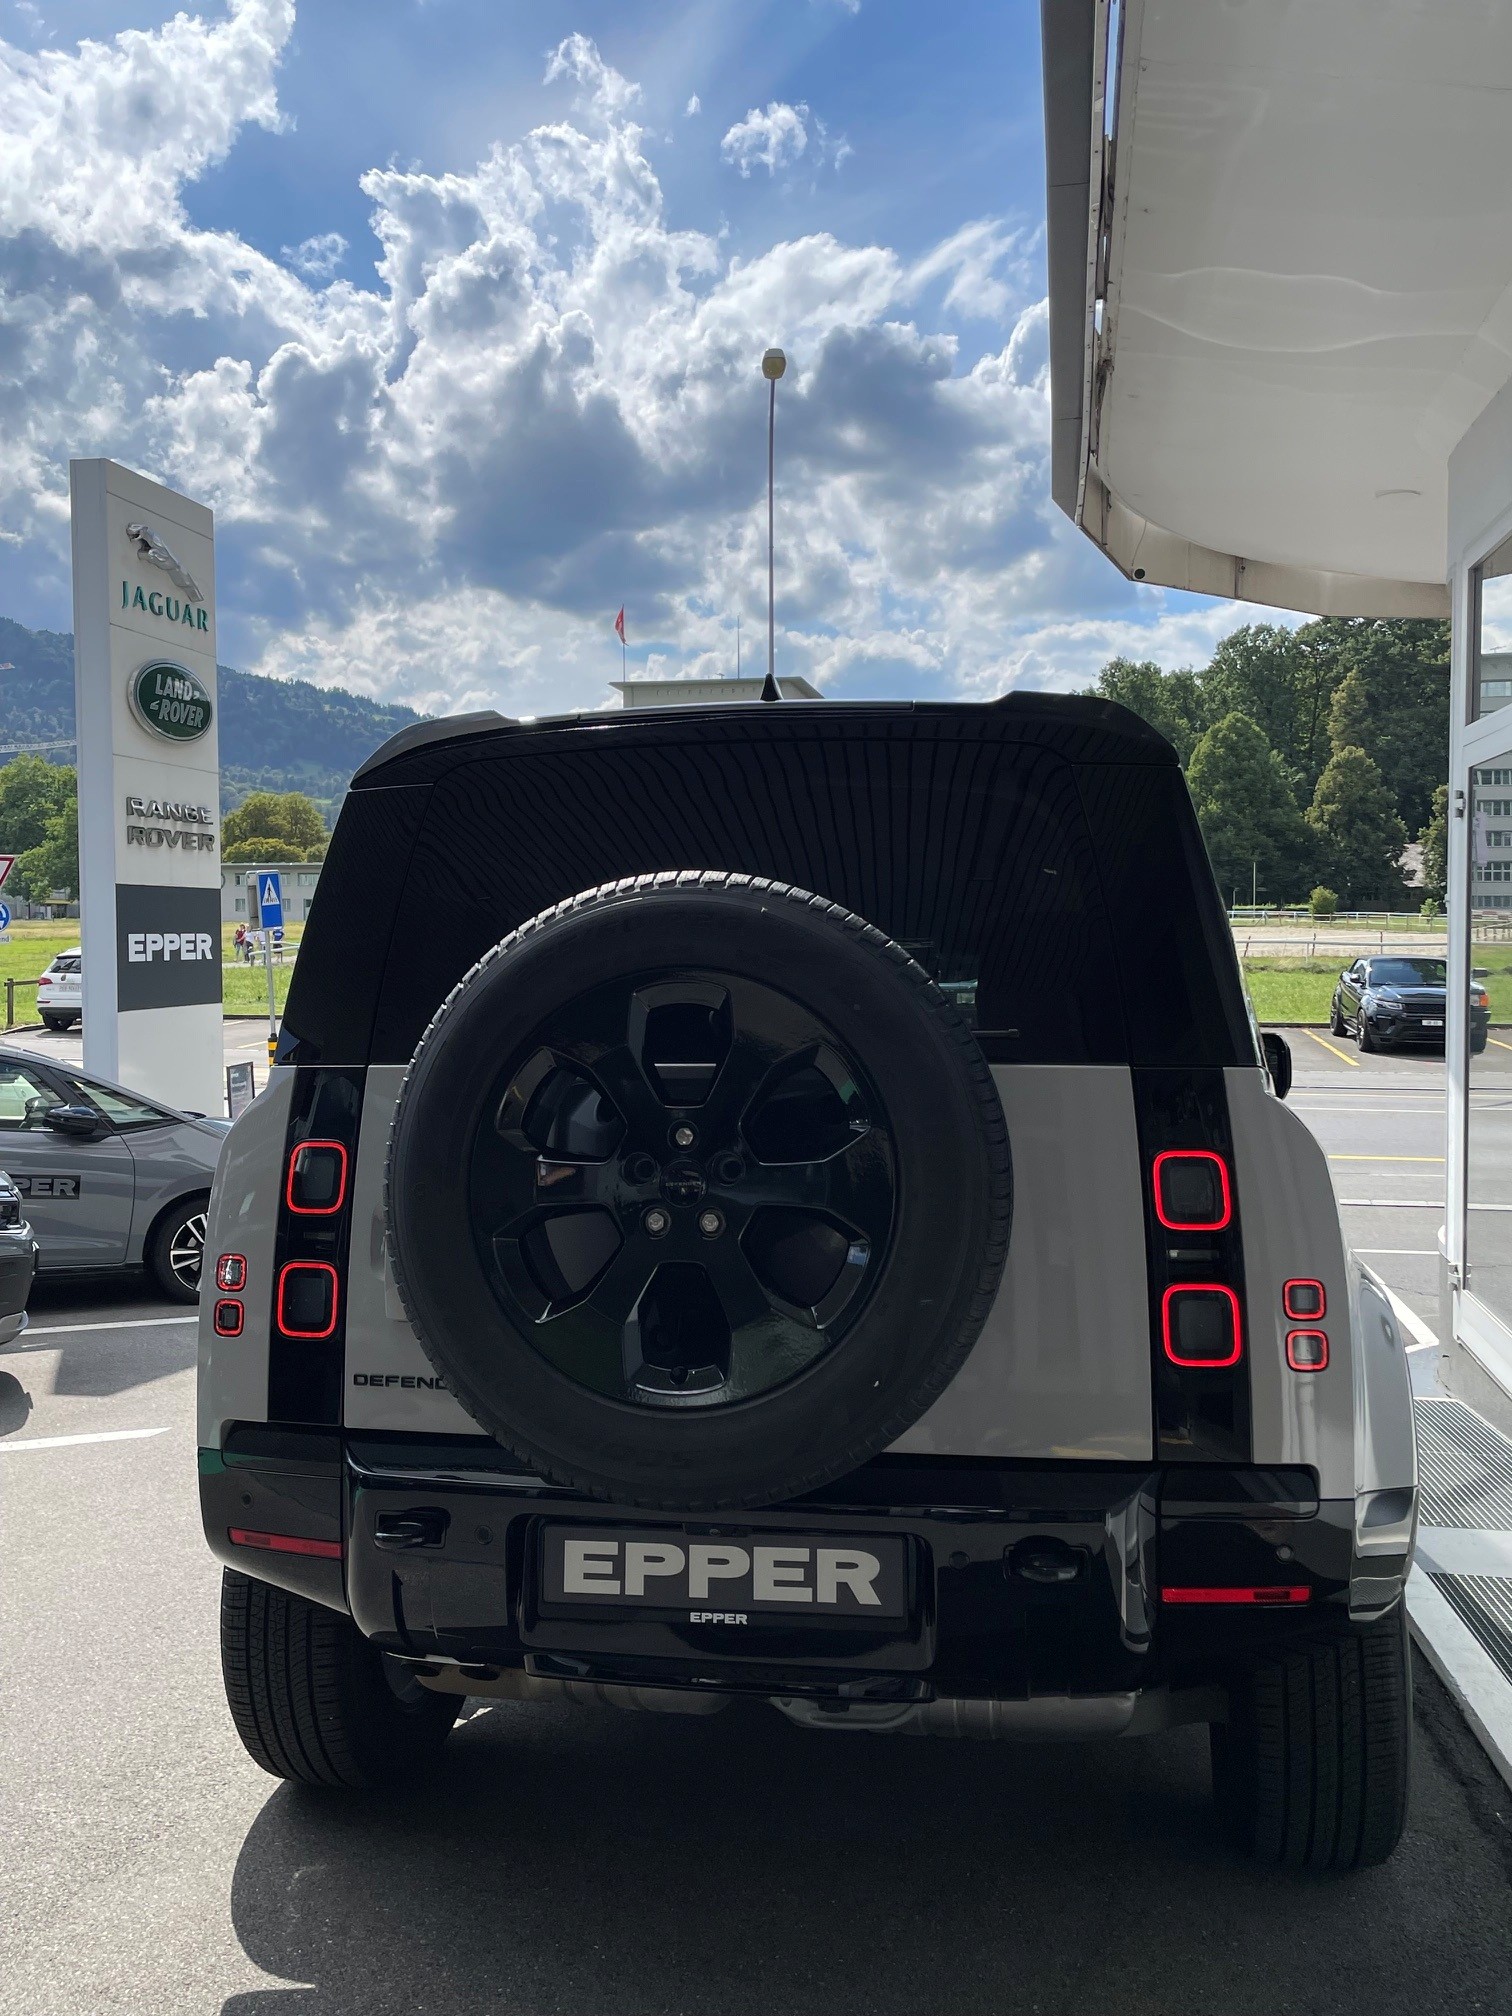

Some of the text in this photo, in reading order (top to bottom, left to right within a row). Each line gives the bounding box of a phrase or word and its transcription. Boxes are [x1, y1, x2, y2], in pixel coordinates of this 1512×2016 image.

[121, 581, 210, 632] JAGUAR
[155, 673, 193, 701] LAND
[158, 698, 204, 728] ROVER
[126, 796, 214, 825] RANGE
[127, 825, 215, 852] ROVER
[128, 933, 213, 962] EPPER
[563, 1540, 882, 1606] EPPER
[689, 1612, 748, 1625] EPPER
